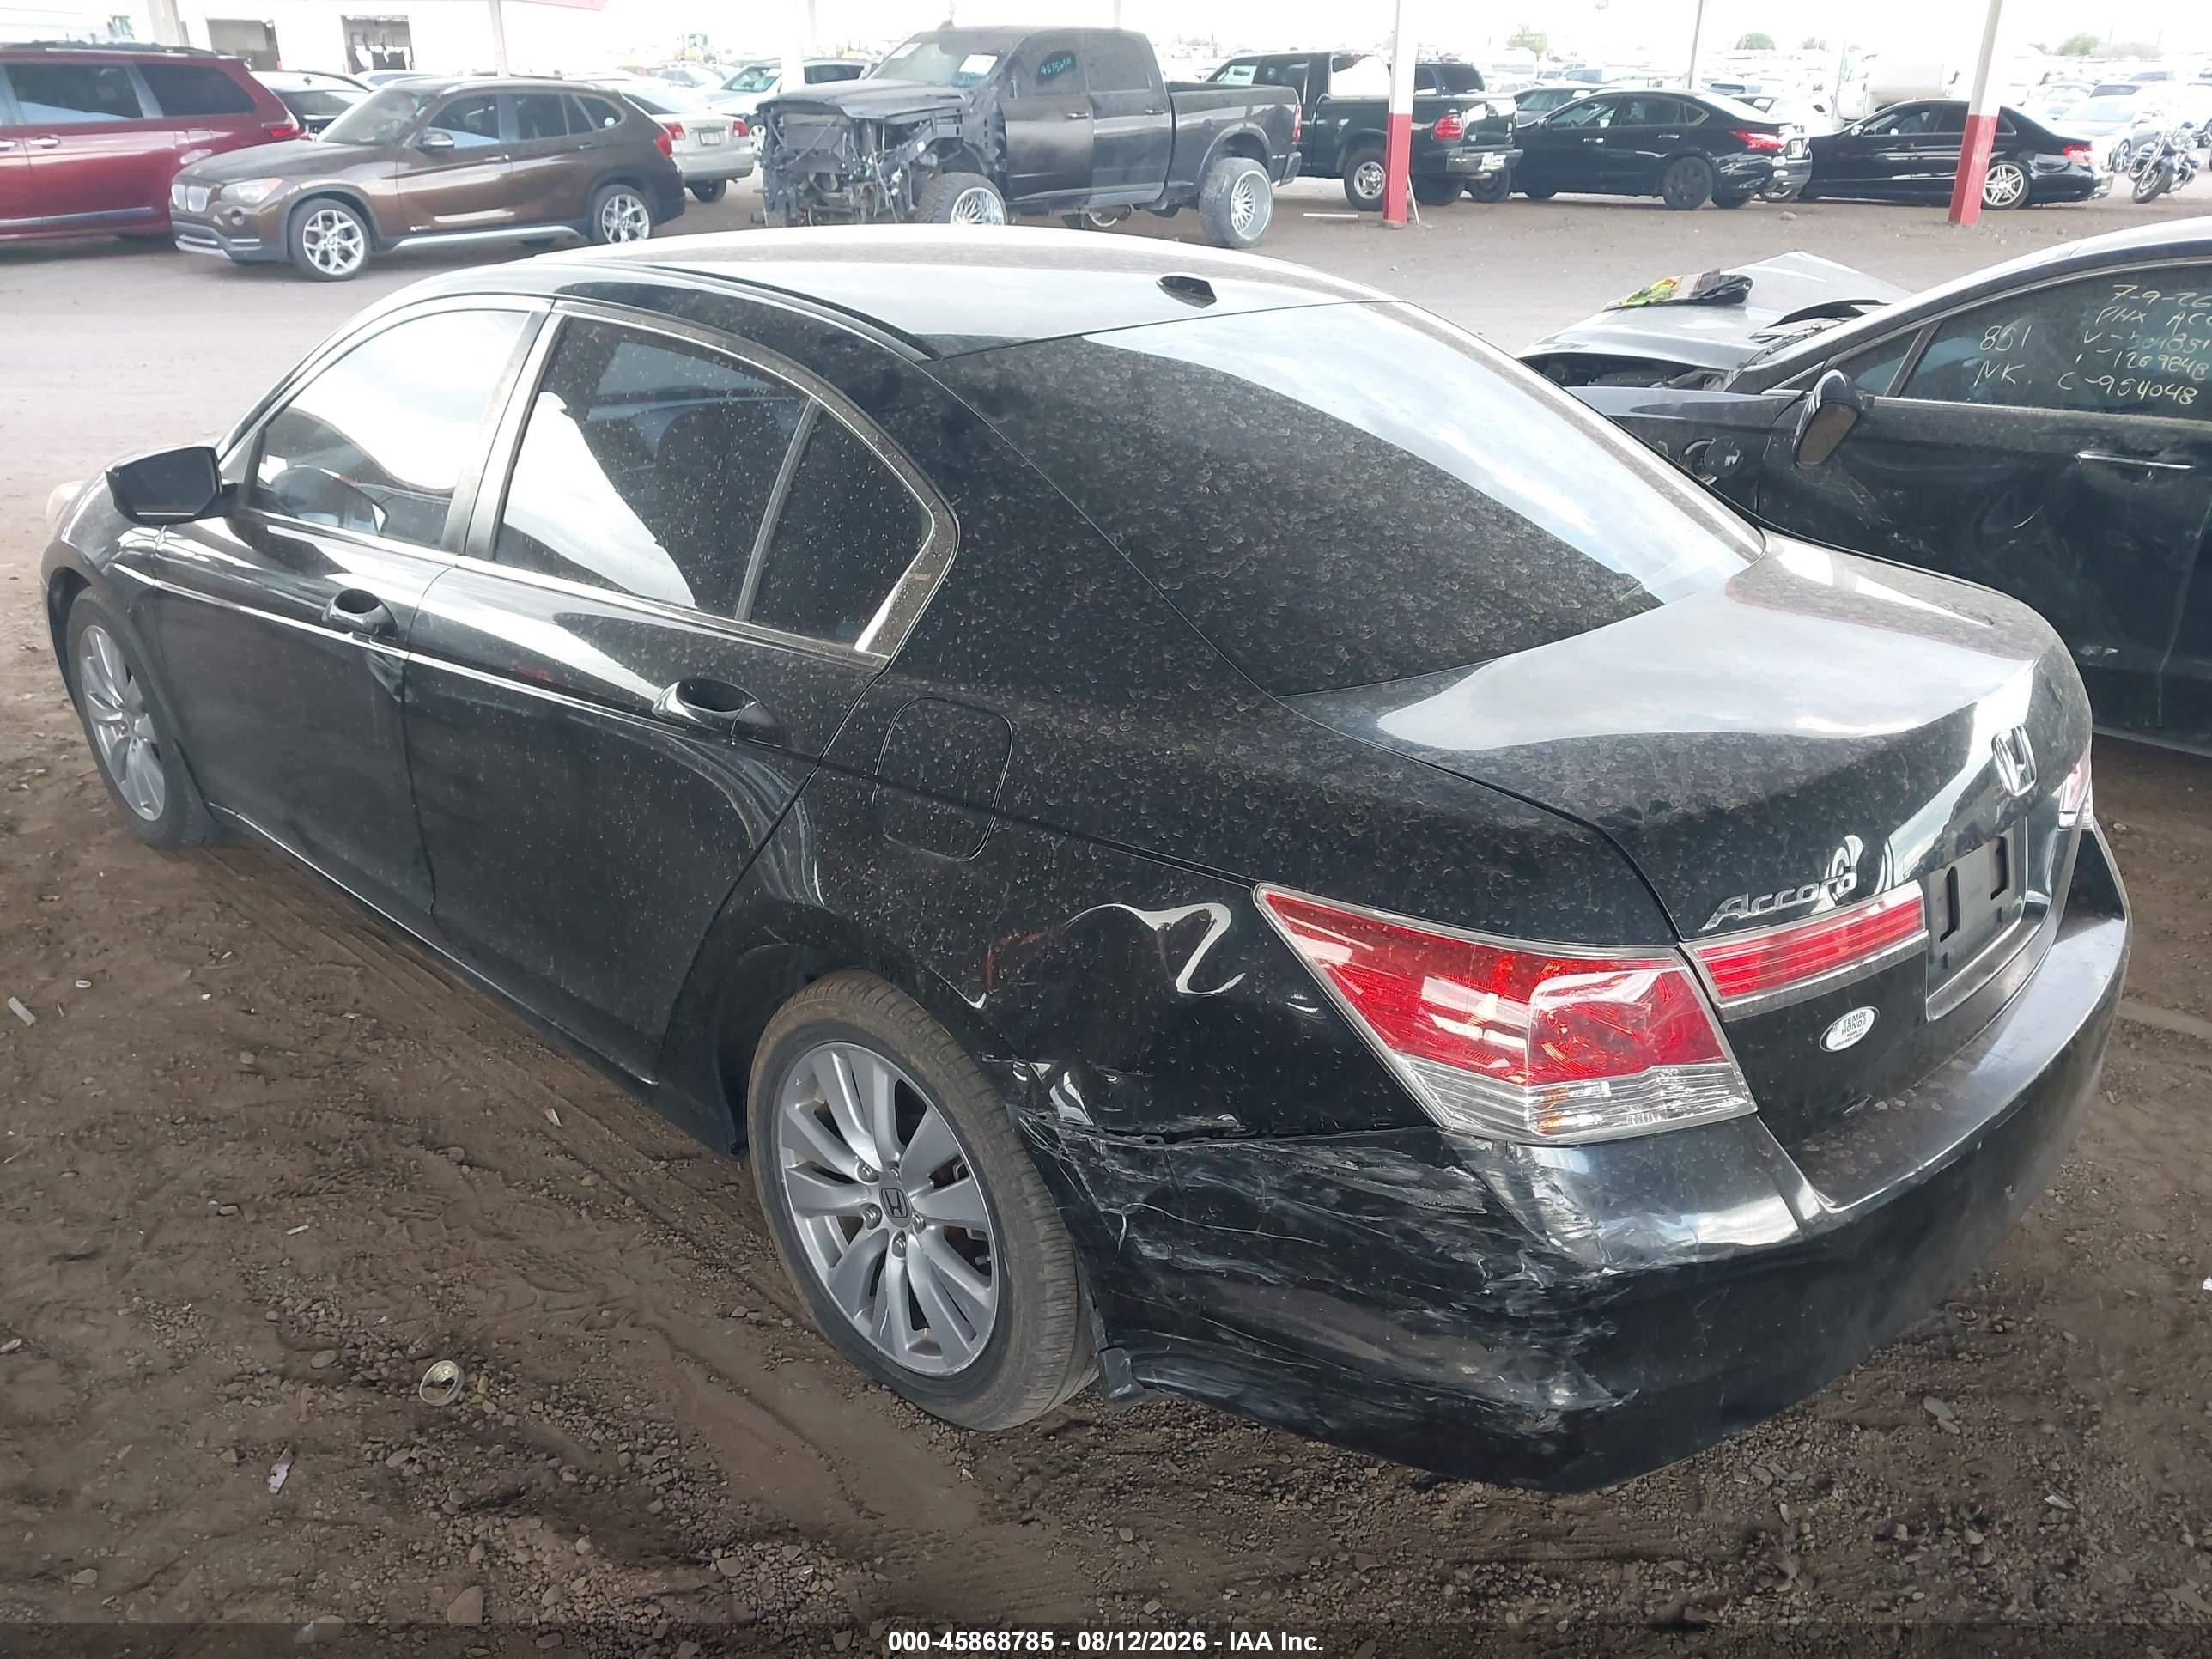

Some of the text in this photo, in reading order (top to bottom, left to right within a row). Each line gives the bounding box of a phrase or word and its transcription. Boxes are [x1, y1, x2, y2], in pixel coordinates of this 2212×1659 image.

[1979, 324, 2033, 351] 851
[1698, 864, 1857, 932] Accord
[1841, 1018, 1867, 1036] HONDA
[1843, 1011, 1867, 1028] TEMPE
